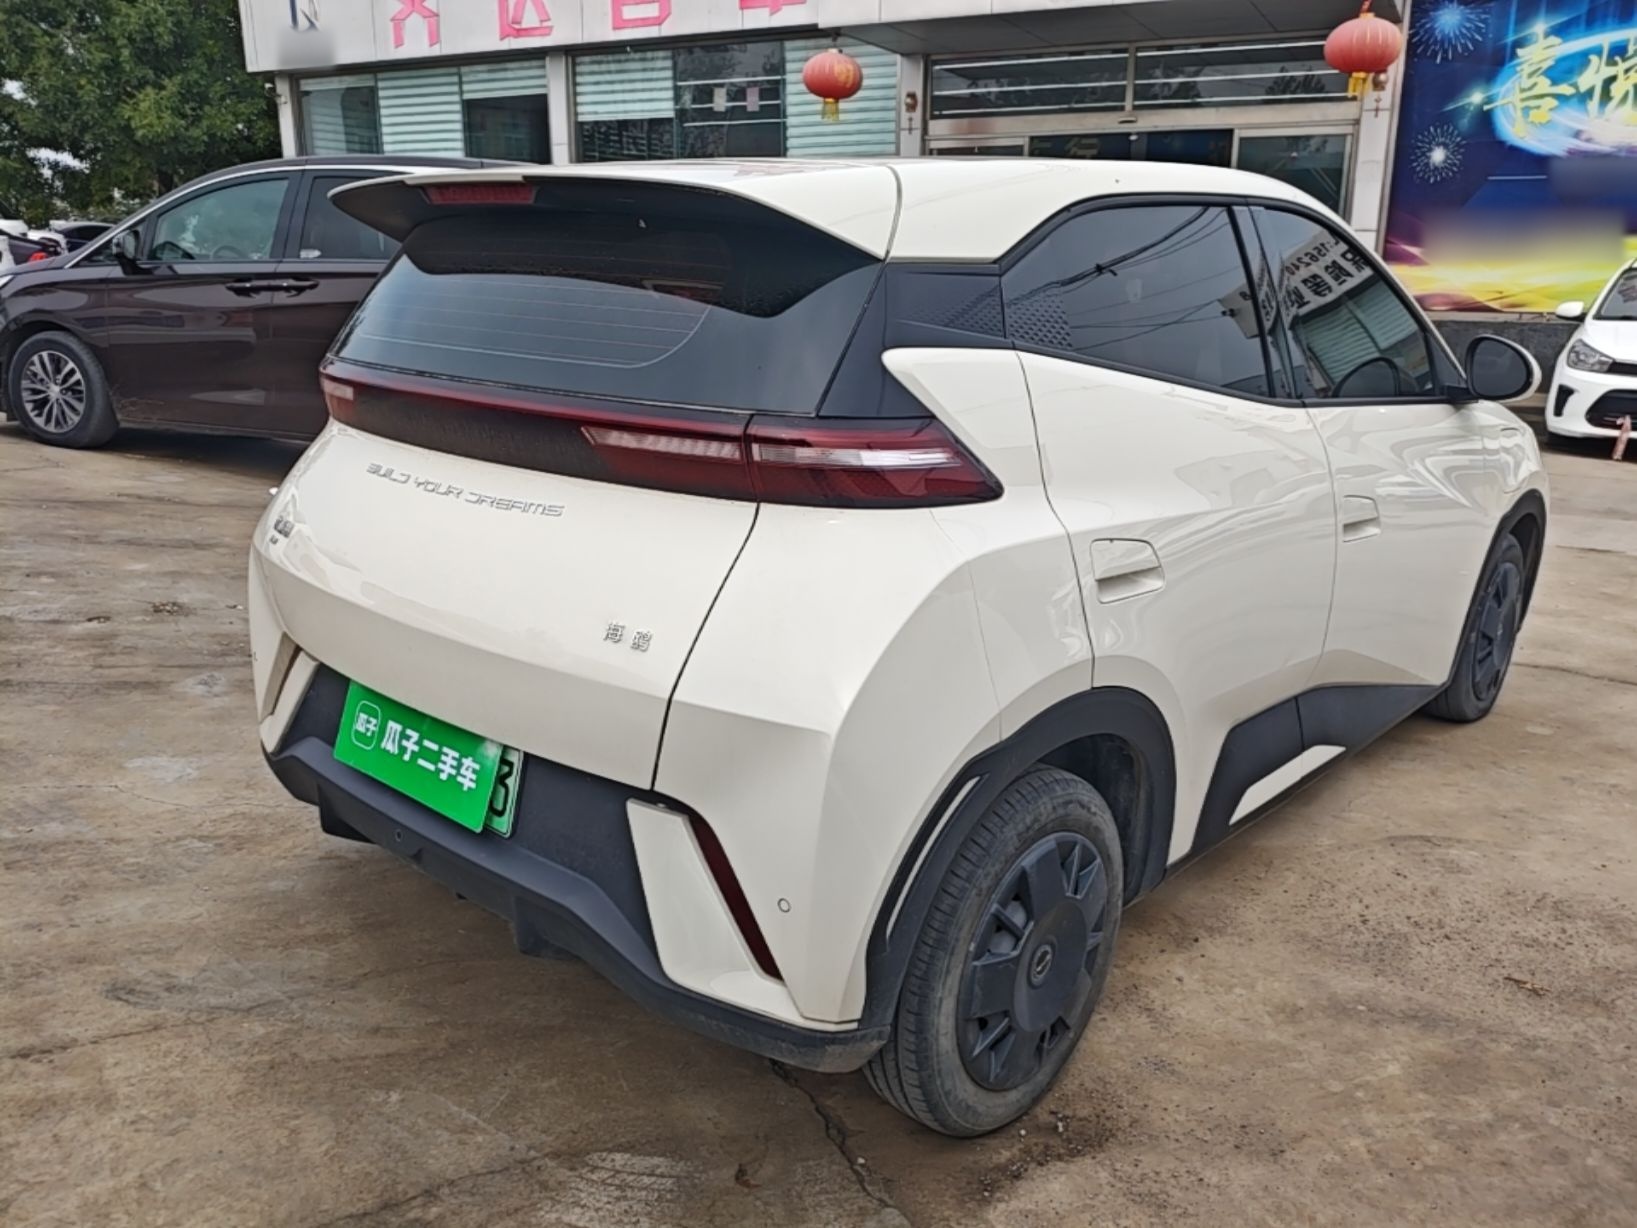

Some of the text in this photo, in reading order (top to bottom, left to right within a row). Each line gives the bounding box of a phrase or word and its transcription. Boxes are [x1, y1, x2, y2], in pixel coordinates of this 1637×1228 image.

[366, 462, 565, 517] BUILD YOUR DREAMS
[381, 719, 481, 792] 瓜子二手车
